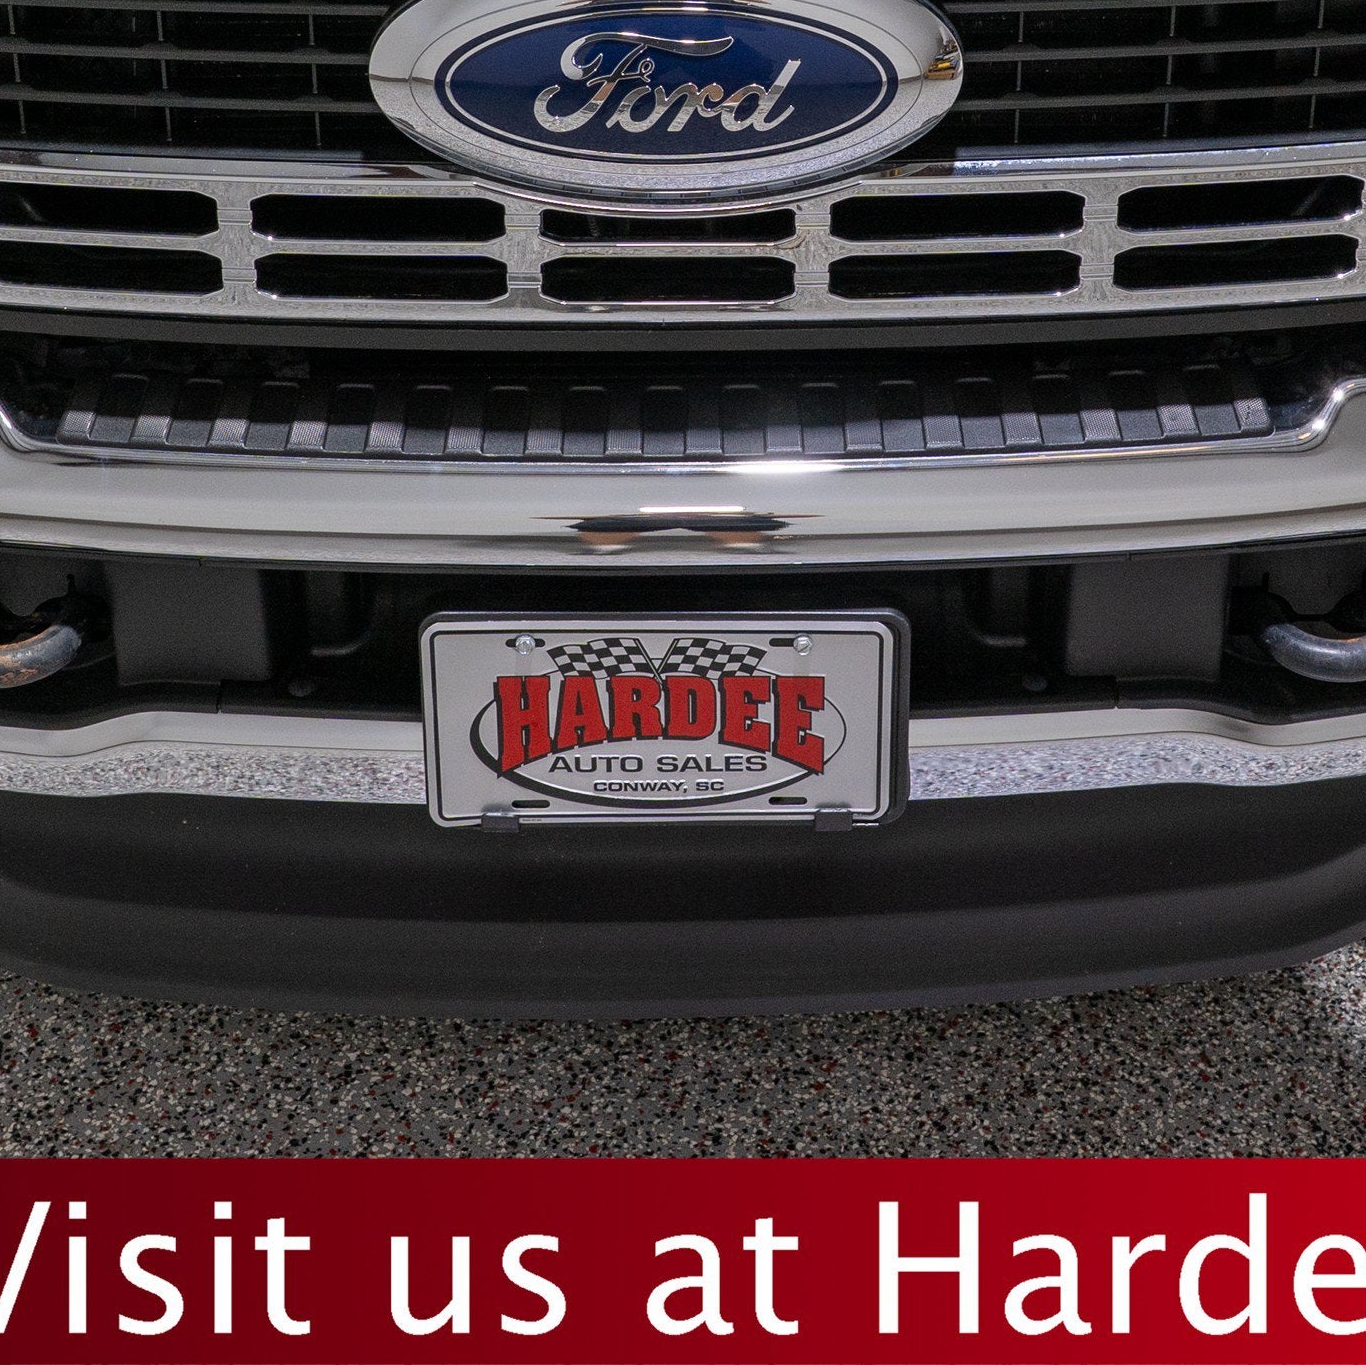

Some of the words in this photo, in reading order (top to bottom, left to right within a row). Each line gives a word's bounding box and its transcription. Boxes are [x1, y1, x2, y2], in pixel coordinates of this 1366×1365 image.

[533, 32, 803, 133] Ford
[495, 675, 826, 777] HARDEE
[548, 755, 644, 773] AUTO
[656, 754, 768, 773] SALES
[592, 780, 688, 794] CONWAY,
[696, 779, 725, 793] SC
